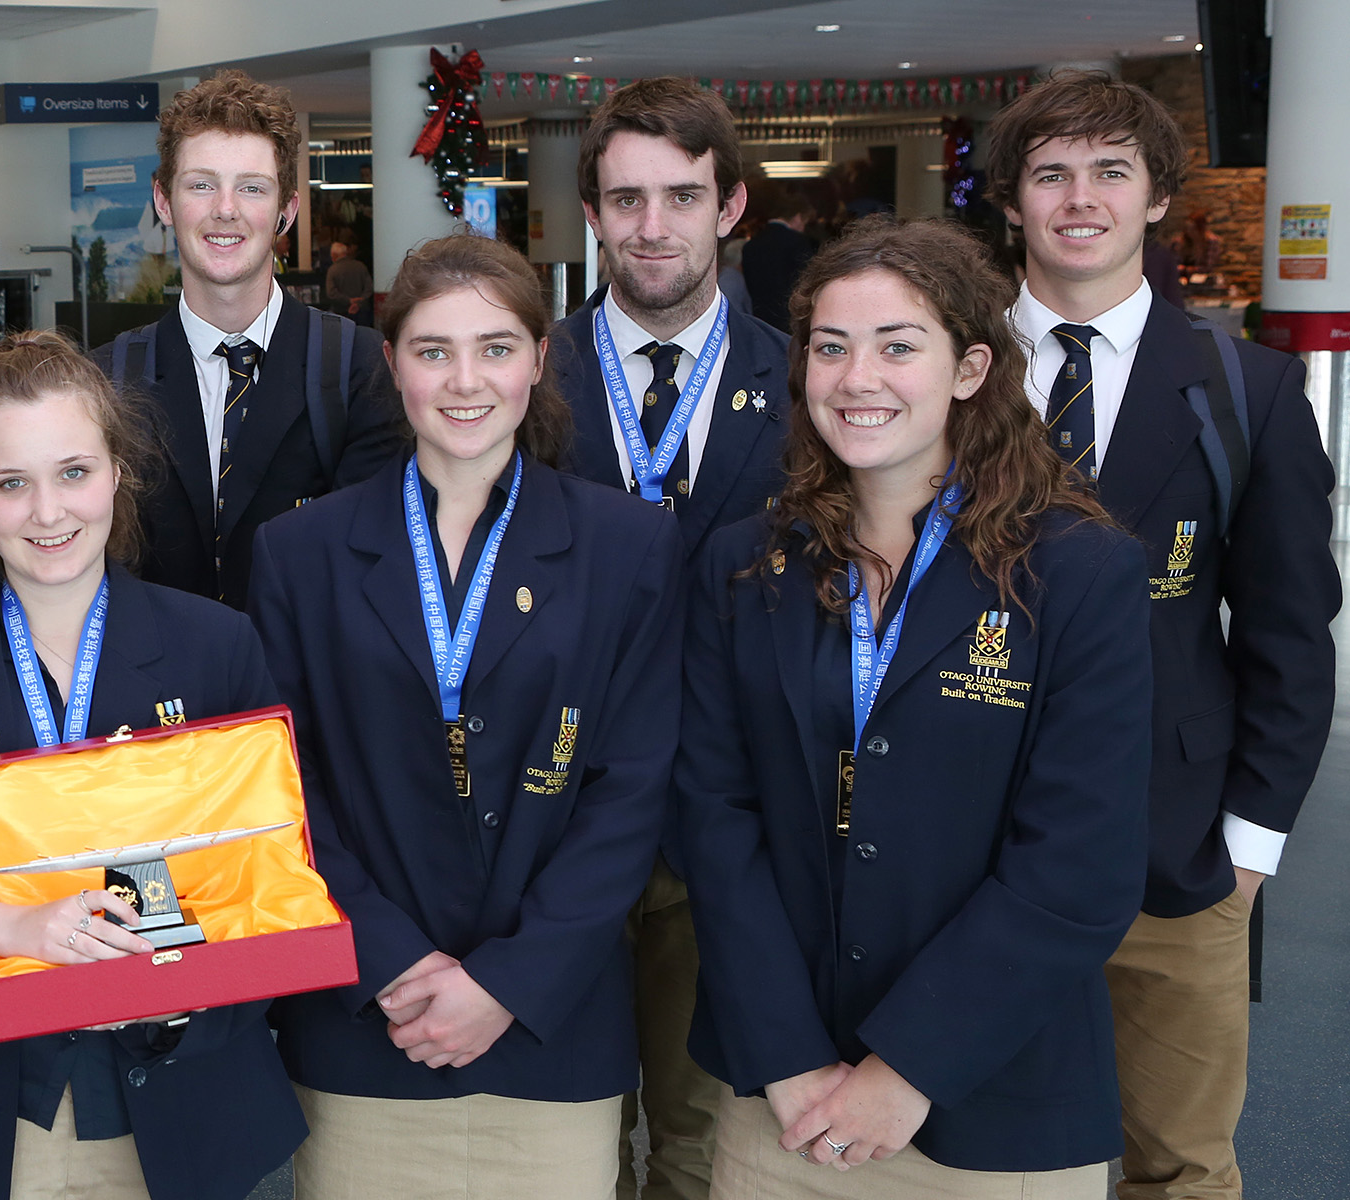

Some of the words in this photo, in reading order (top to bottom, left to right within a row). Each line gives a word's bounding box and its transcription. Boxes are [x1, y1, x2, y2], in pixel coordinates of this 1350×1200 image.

[42, 98, 94, 111] Oversize
[96, 98, 129, 110] Items
[1160, 583, 1183, 591] ROWING
[939, 670, 975, 682] OTAGO
[975, 675, 1032, 692] UNIVERSITY
[964, 682, 1007, 696] ROWING
[940, 687, 966, 699] Built
[967, 692, 981, 702] on
[983, 693, 1026, 709] Tradition
[526, 767, 553, 779] OTAGO
